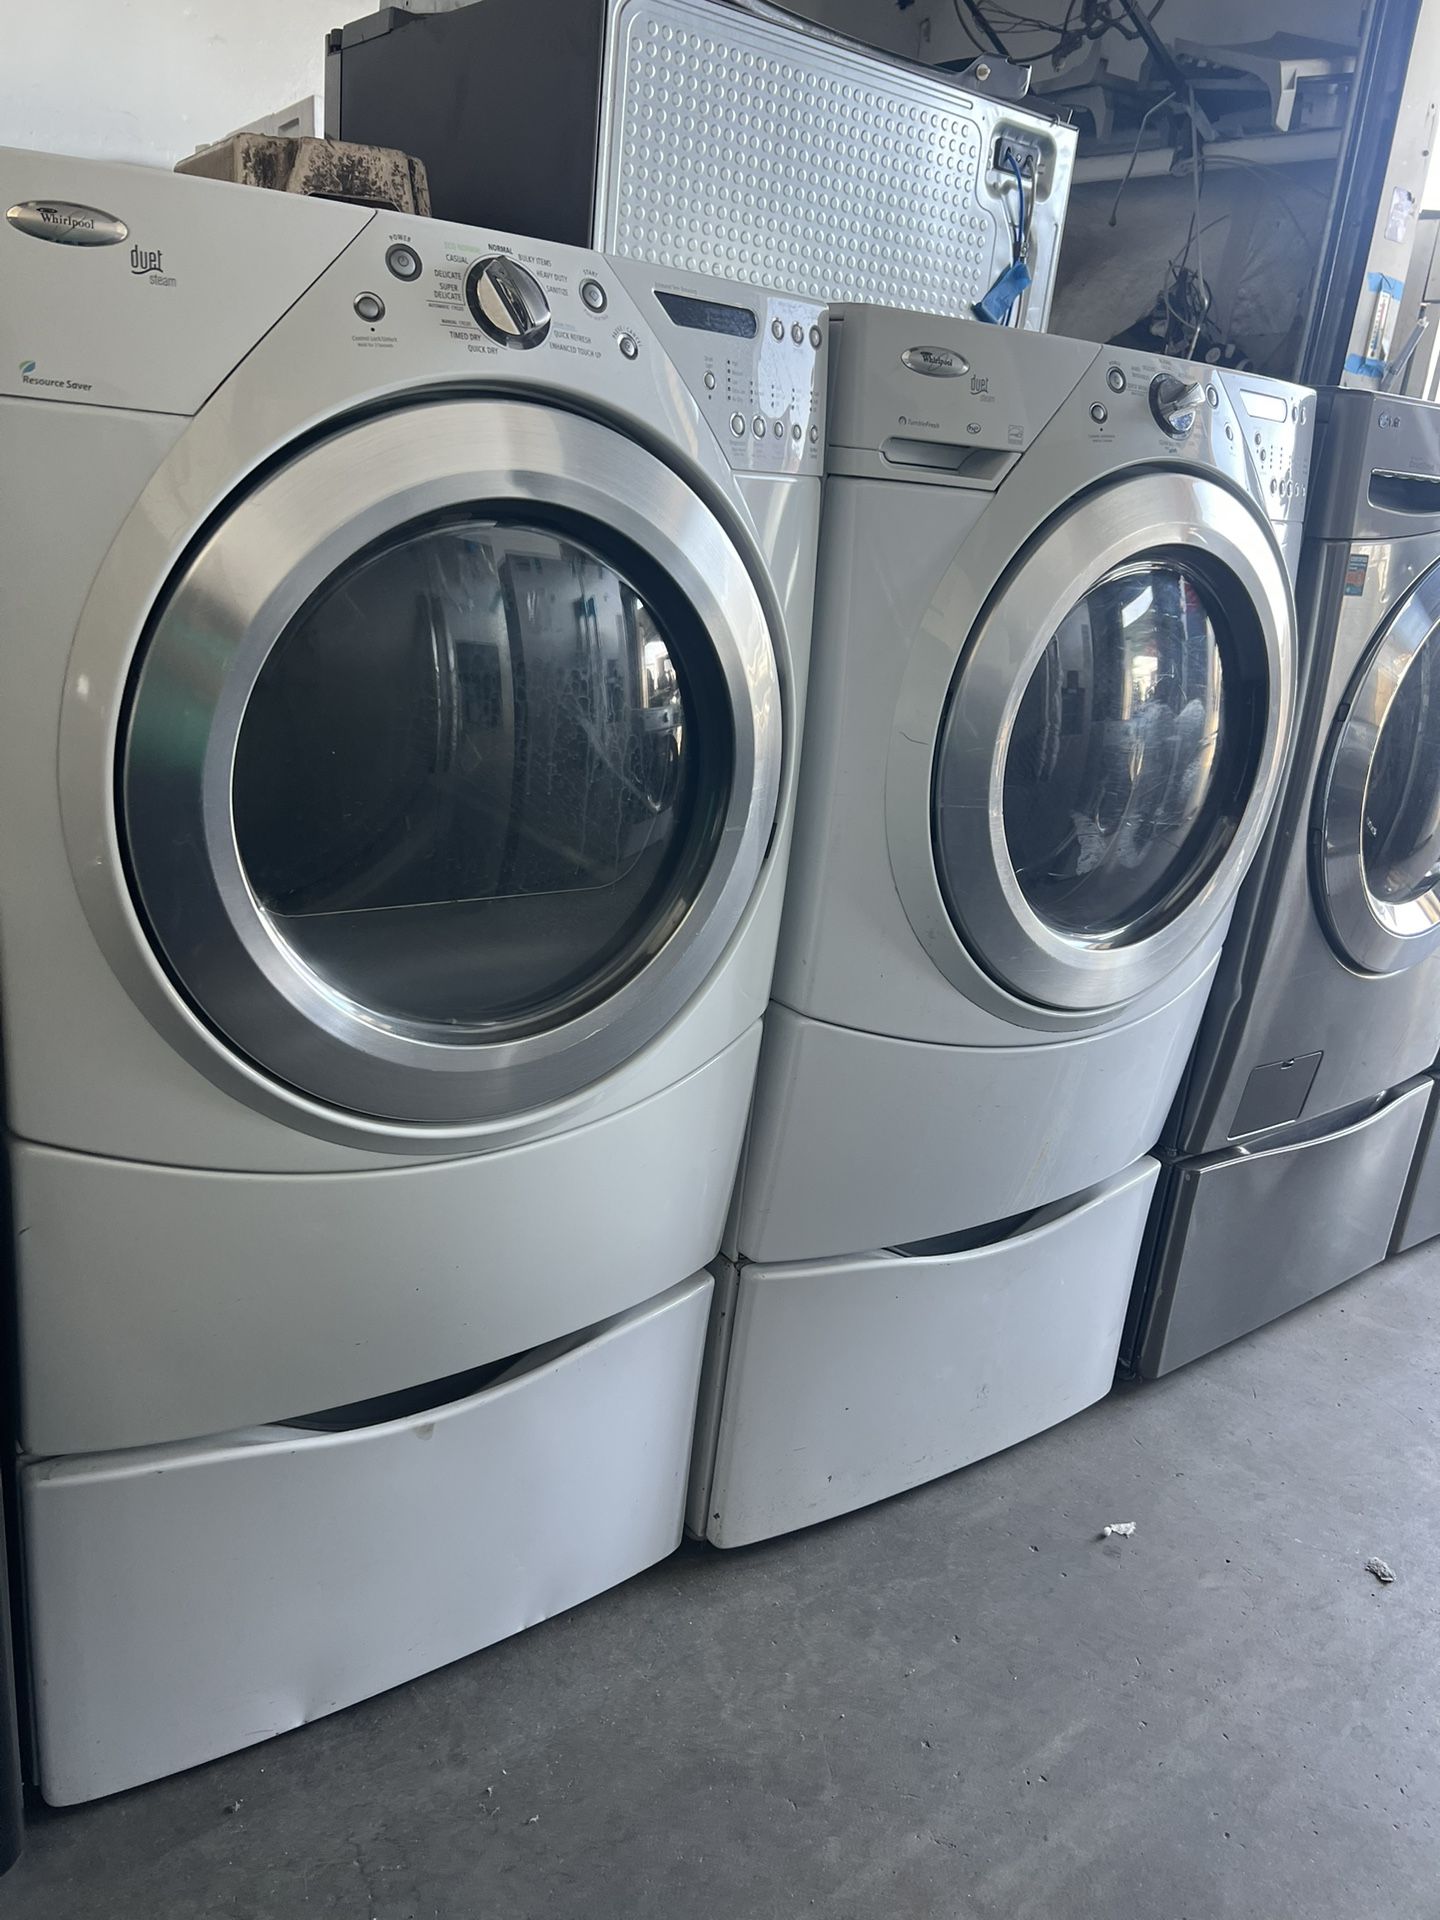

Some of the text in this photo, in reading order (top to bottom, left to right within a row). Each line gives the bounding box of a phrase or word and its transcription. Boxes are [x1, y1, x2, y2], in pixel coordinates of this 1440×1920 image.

[40, 212, 94, 229] Whirlpool
[389, 234, 411, 242] POWER
[488, 243, 513, 254] NORMAL
[130, 244, 163, 272] duet
[446, 254, 468, 264] CASUAL
[518, 254, 552, 267] BULKY ITEMS
[434, 269, 462, 280] DELICATE
[536, 270, 568, 283] HEAVY DUTY
[583, 268, 599, 278] START
[149, 274, 177, 287] steam
[439, 282, 458, 291] SUPER
[546, 285, 568, 296] SANITIZE
[434, 290, 462, 301] DELICATE
[449, 331, 481, 341] TIMED DRY
[553, 330, 570, 339] QUICK
[468, 344, 498, 355] QUICK DRY
[549, 342, 577, 354] ENHANCED
[578, 347, 594, 357] TOUCH
[922, 354, 953, 367] Whirlpool
[23, 375, 93, 391] Resource Saver
